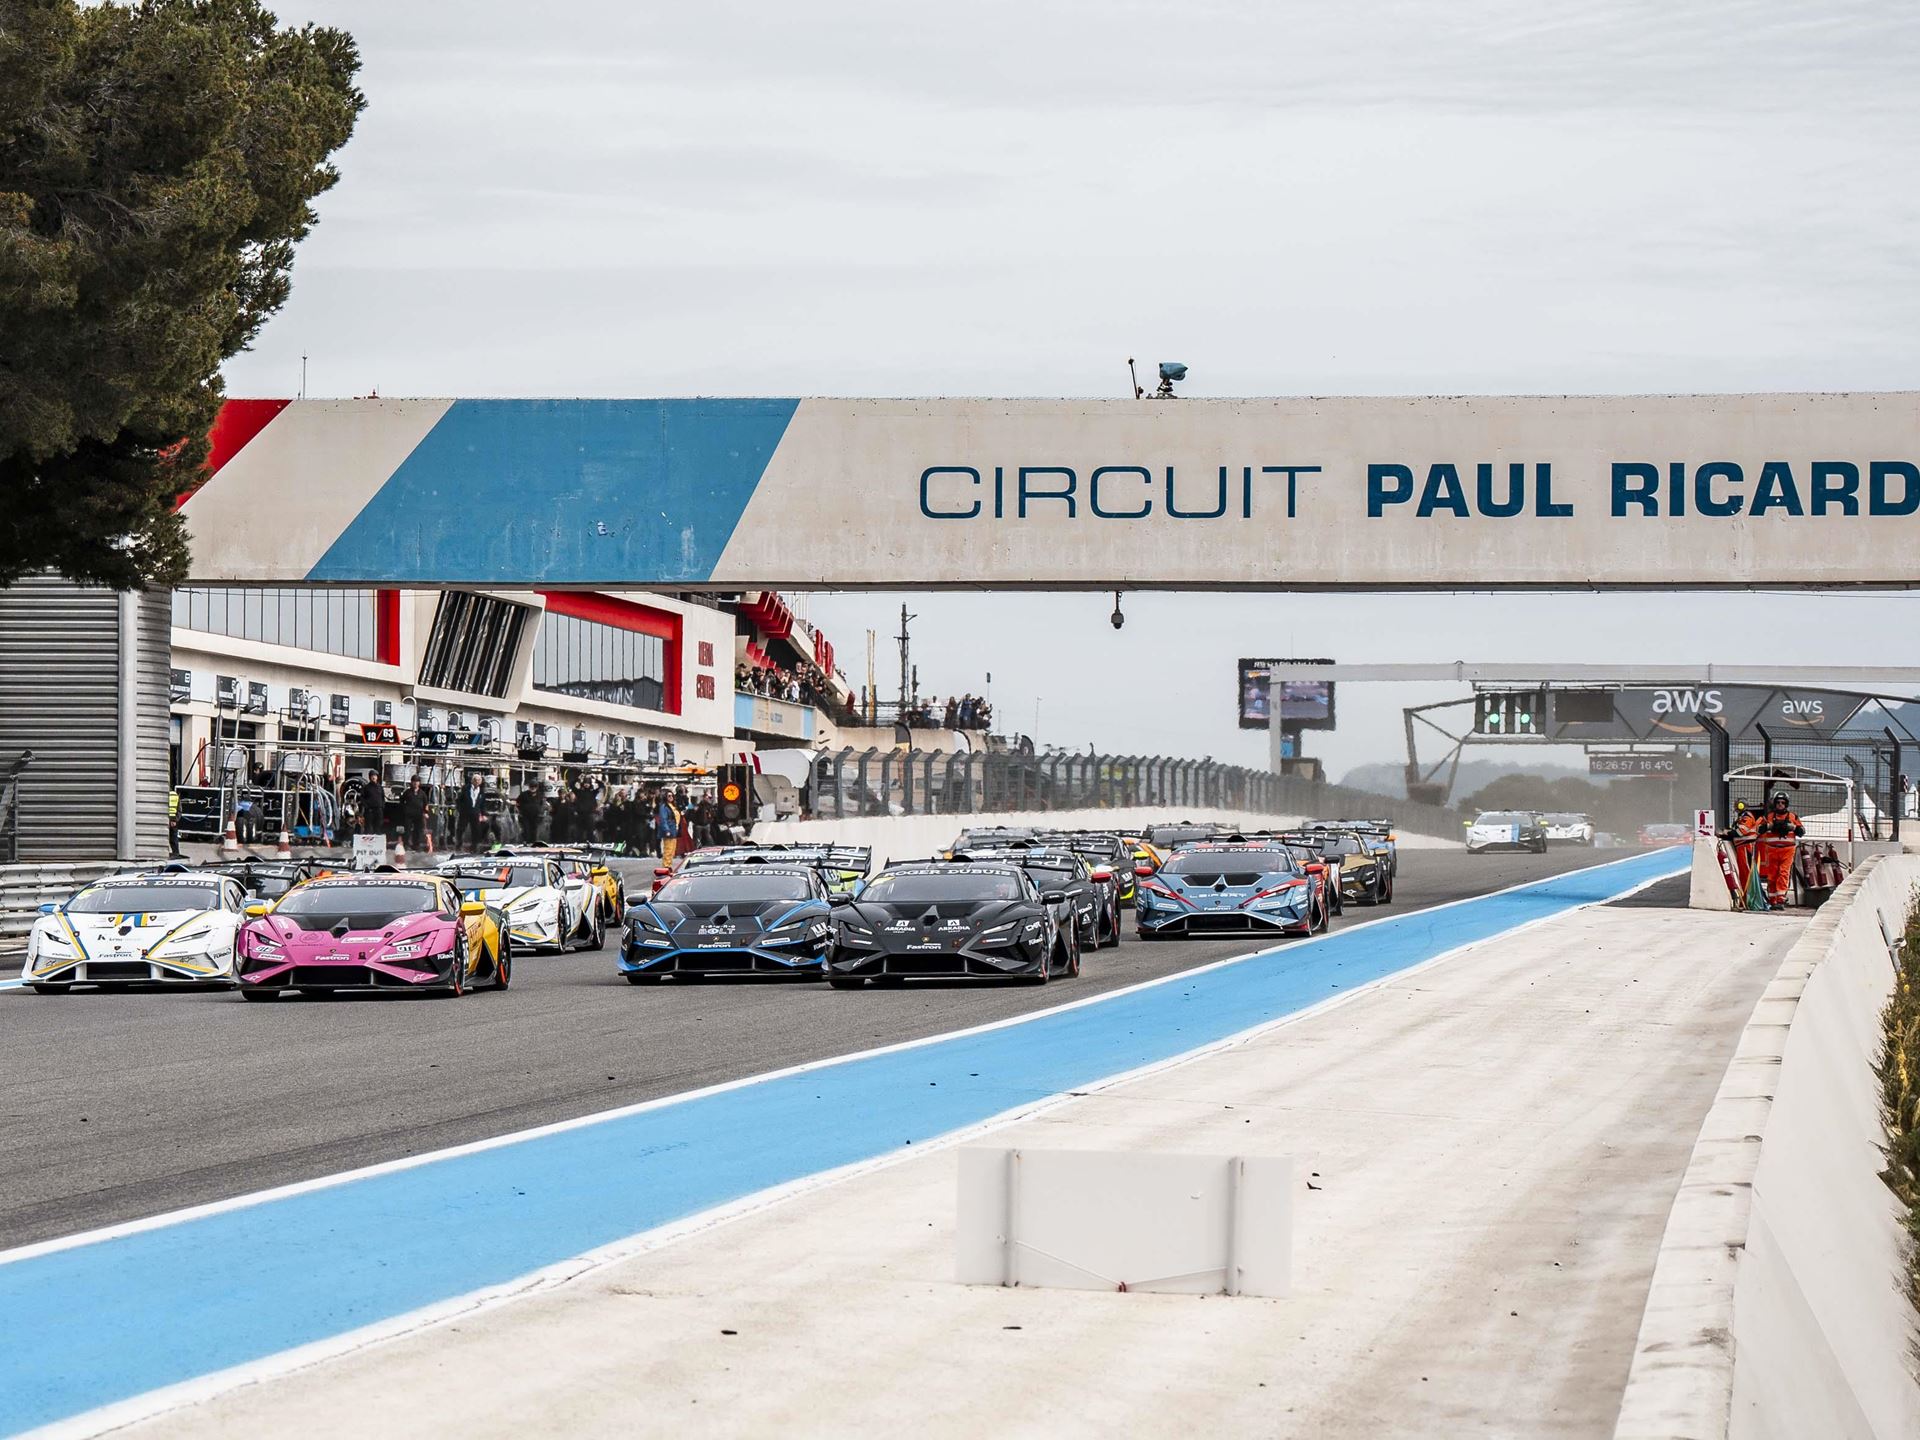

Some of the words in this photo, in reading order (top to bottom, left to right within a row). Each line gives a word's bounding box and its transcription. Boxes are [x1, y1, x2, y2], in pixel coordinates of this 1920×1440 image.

[920, 466, 1321, 518] CIRCUIT
[1368, 464, 1573, 517] PAUL
[1612, 462, 1920, 516] RICARD
[1652, 690, 1723, 713] aws
[1782, 700, 1823, 714] aws
[366, 731, 377, 741] 19
[382, 728, 394, 738] 63
[420, 737, 430, 746] 19
[436, 734, 447, 743] 63
[681, 870, 734, 878] ROGER
[884, 869, 940, 877] ROGER
[94, 881, 148, 889] ROGER
[304, 880, 359, 888] ROGER
